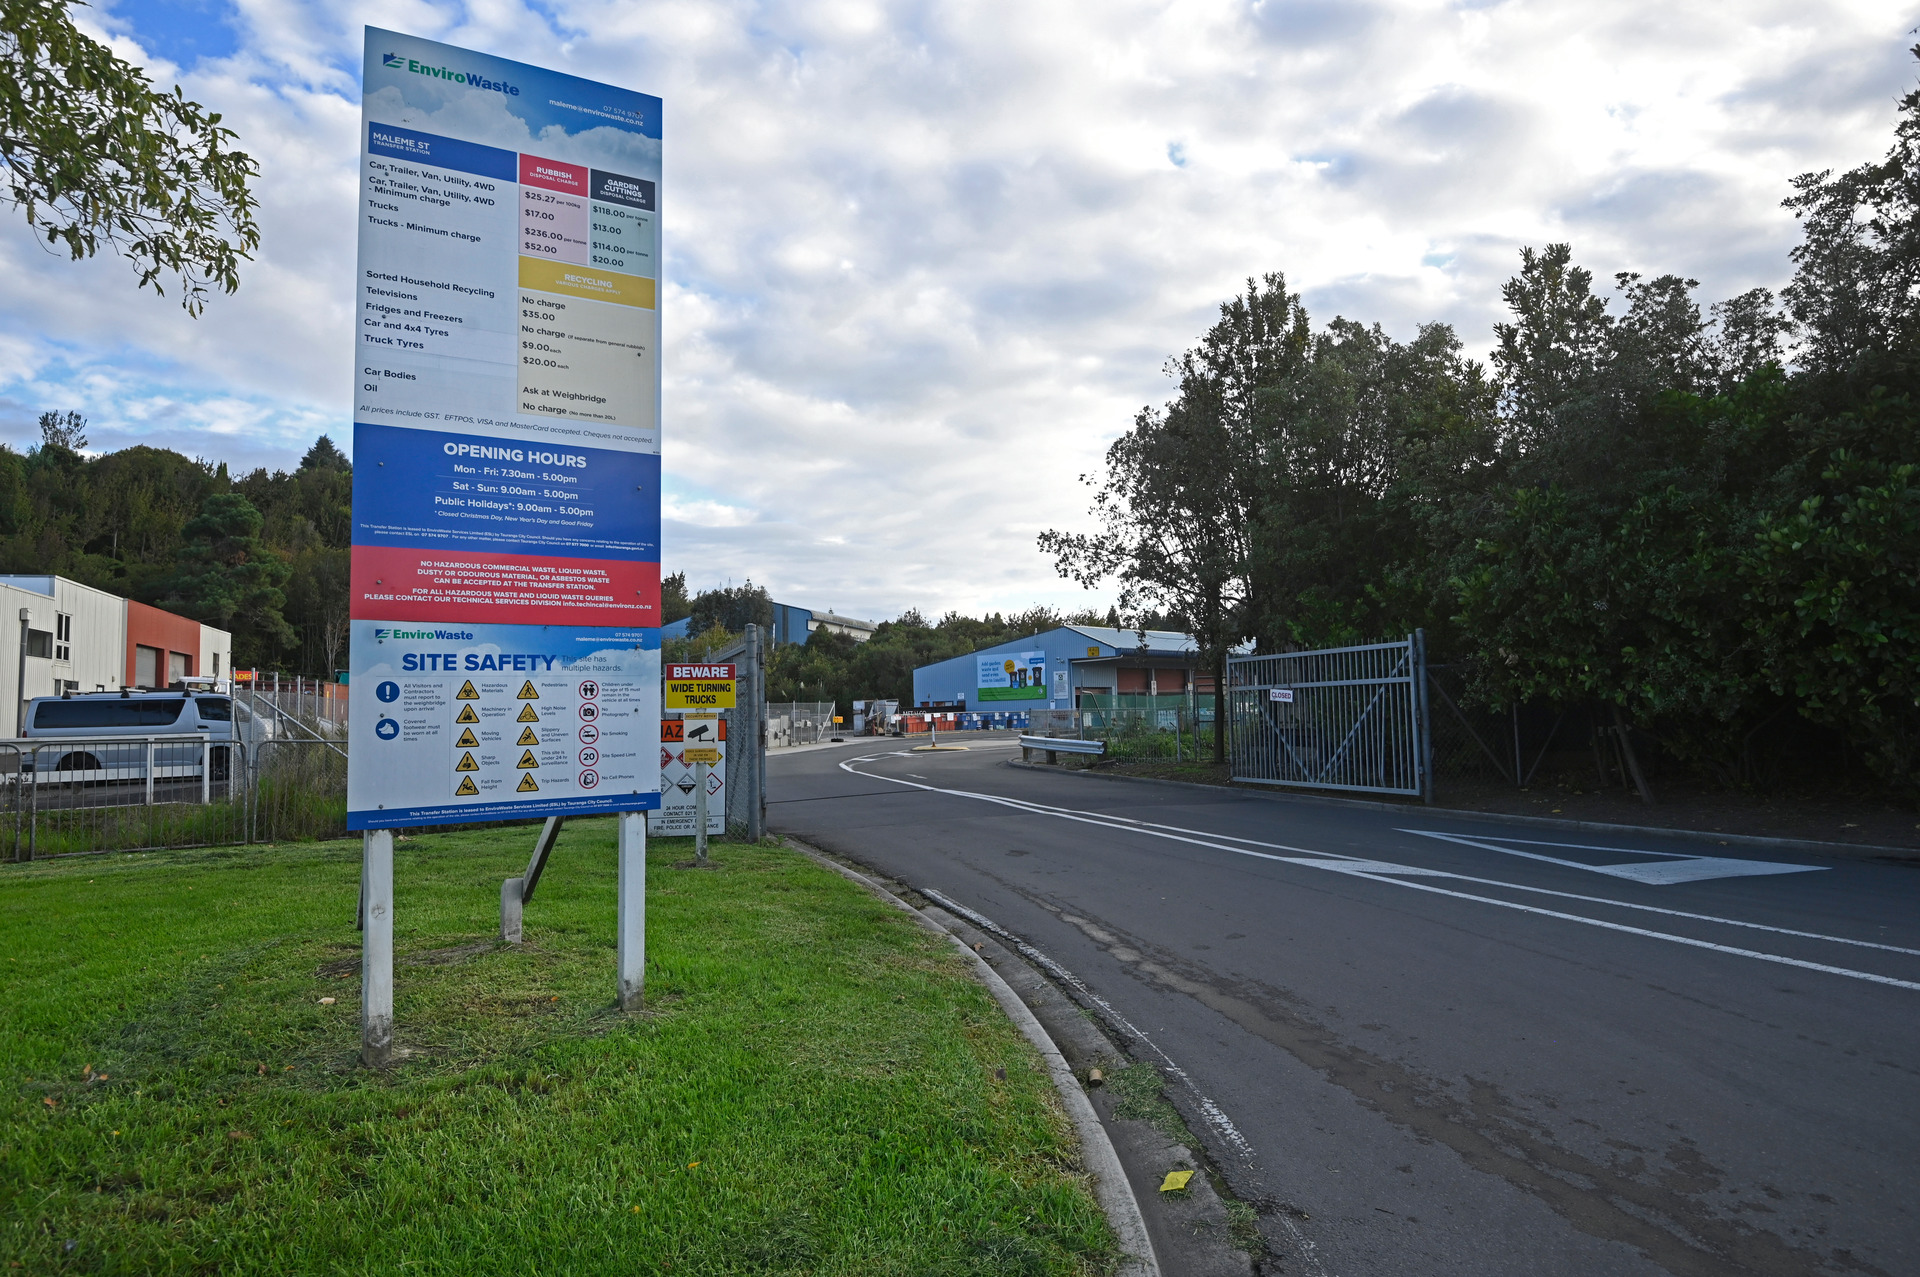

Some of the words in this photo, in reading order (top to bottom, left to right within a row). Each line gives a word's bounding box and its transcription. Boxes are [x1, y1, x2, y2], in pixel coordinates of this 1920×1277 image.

[408, 59, 519, 95] EnviroWaste
[549, 99, 643, 126] maleme@envirowaste.co.nz
[613, 107, 626, 116] 574
[373, 132, 415, 147] MALEME
[417, 141, 430, 150] ST
[373, 139, 404, 150] TRANSFER
[405, 146, 430, 155] STATION
[369, 160, 387, 171] Car,
[389, 164, 419, 177] Trailer,
[421, 170, 441, 182] Van,
[443, 175, 471, 188] Utility,
[473, 181, 495, 191] 4WD
[529, 172, 556, 182] DISPOSAL
[556, 177, 578, 186] CHARGE
[536, 166, 572, 180] RUBBISH
[368, 176, 387, 186] Car,
[388, 179, 419, 192] Trailer,
[421, 185, 441, 196] Van,
[443, 190, 471, 202] Utility,
[473, 196, 495, 206] 4WD
[604, 184, 642, 198] CUTTINGS
[607, 179, 639, 191] GARDEN
[374, 185, 417, 200] Minimum
[419, 195, 451, 207] charge
[524, 191, 556, 204] $25.27
[599, 190, 624, 199] DISPOSAL
[625, 195, 646, 204] CHARGE
[368, 199, 399, 212] Trucks
[592, 205, 625, 219] $118.00
[525, 208, 554, 221] $17.00
[368, 215, 398, 227] Trucks
[406, 222, 448, 236] Minimum
[450, 231, 481, 243] charge
[524, 227, 563, 241] $236.00
[592, 222, 621, 235] $13.00
[524, 241, 557, 254] $52.00
[592, 241, 626, 254] $114.00
[592, 255, 624, 267] $20.00
[366, 270, 398, 282] Sorted
[400, 275, 450, 290] Household
[452, 284, 495, 299] Recycling
[555, 280, 579, 288] VARIOUS
[579, 284, 604, 292] CHARGES
[564, 273, 613, 288] RECYCLING
[366, 286, 418, 301] Televisions
[522, 296, 535, 304] No
[536, 299, 566, 310] charge
[366, 302, 401, 314] Fridges
[403, 309, 421, 317] and
[424, 310, 463, 323] Freezers
[522, 309, 555, 321] $35.00
[364, 318, 381, 327] Car
[383, 322, 401, 330] and
[404, 324, 421, 333] 4x4
[424, 326, 449, 336] Tyres
[521, 324, 534, 333] No
[536, 327, 566, 339] charge
[364, 334, 393, 345] Truck
[396, 338, 424, 349] Tyres
[522, 340, 550, 352] $9.00
[523, 356, 557, 368] $20.00
[364, 367, 381, 376] Car
[384, 369, 416, 380] Bodies
[364, 383, 377, 392] Oil
[522, 386, 539, 395] Ask
[552, 390, 606, 404] Weighbridge
[522, 402, 536, 410] No
[537, 404, 567, 415] charge
[443, 442, 523, 462] OPENING
[528, 450, 587, 468] HOURS
[454, 464, 475, 474] Mon
[483, 467, 499, 476] Fri:
[500, 468, 535, 479] 7.30am
[542, 472, 577, 484] 5.00pm
[453, 481, 469, 490] Sat
[477, 483, 498, 493] Sun:
[500, 485, 536, 496] 9.00am
[543, 489, 578, 500] 5.00pm
[435, 496, 465, 506] Public
[516, 502, 552, 513] 9.00am
[559, 506, 593, 517] 5.00pm
[433, 561, 481, 569] HAZARDOUS
[482, 563, 530, 572] COMMERCIAL
[531, 566, 558, 574] WASTE,
[393, 629, 473, 640] EnviroWaste
[402, 653, 457, 671] SITE
[464, 654, 557, 671] SAFETY
[560, 663, 591, 672] multiple
[592, 664, 623, 672] hazards.
[673, 666, 729, 678] BEWARE
[670, 684, 694, 693] WIDE
[696, 683, 731, 692] TURNING
[1271, 691, 1292, 699] CLOSED
[685, 695, 717, 704] TRUCKS
[583, 752, 595, 761] 20
